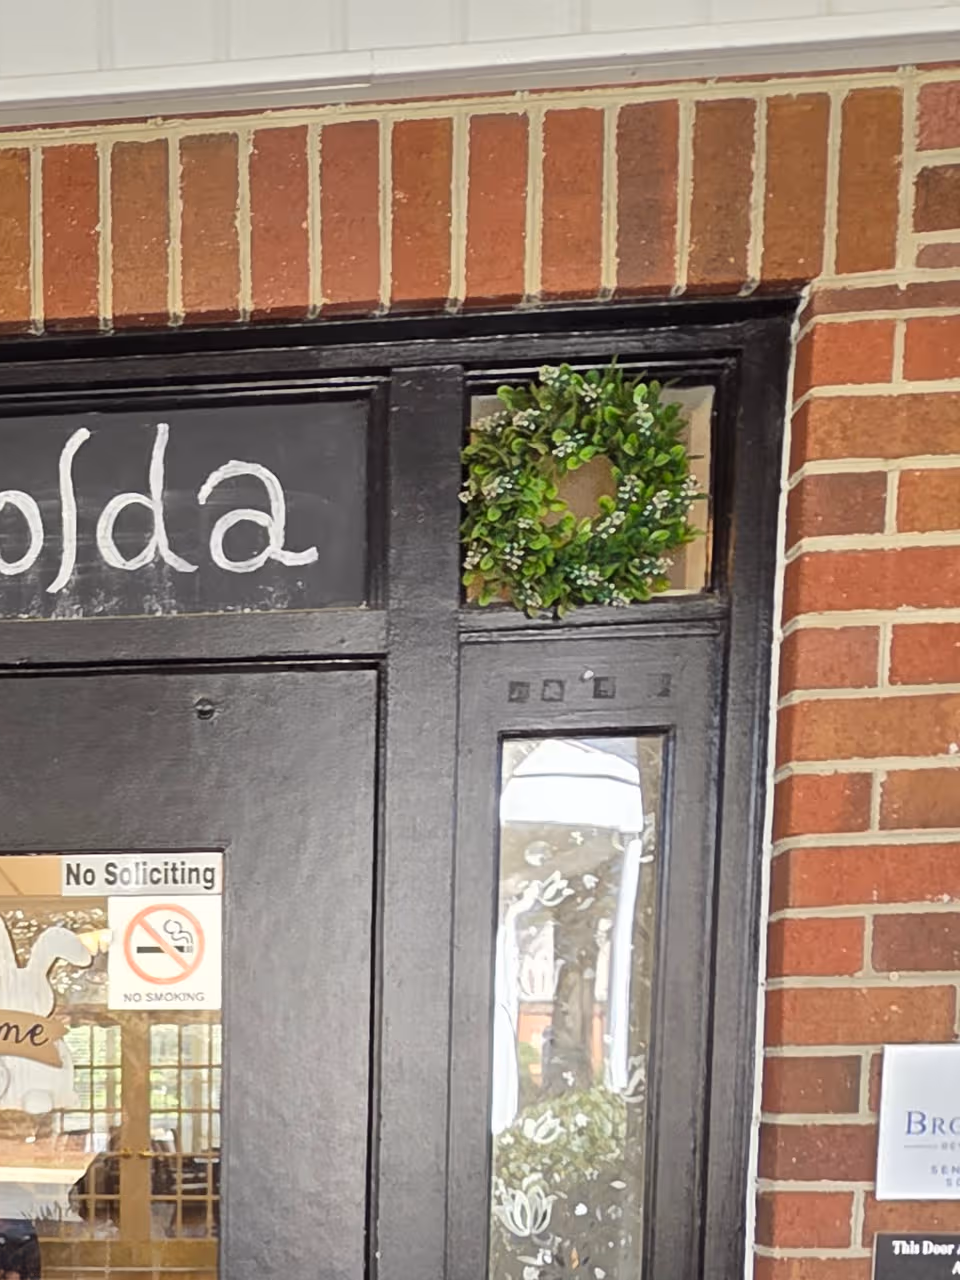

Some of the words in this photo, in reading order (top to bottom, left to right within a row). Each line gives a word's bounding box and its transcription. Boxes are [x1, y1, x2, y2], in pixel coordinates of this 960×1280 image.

[65, 863, 95, 886] No
[104, 861, 215, 890] Soliciting
[123, 993, 142, 1003] NO
[146, 992, 205, 1002] SMOKING
[891, 1240, 920, 1255] This
[922, 1240, 955, 1255] Door
